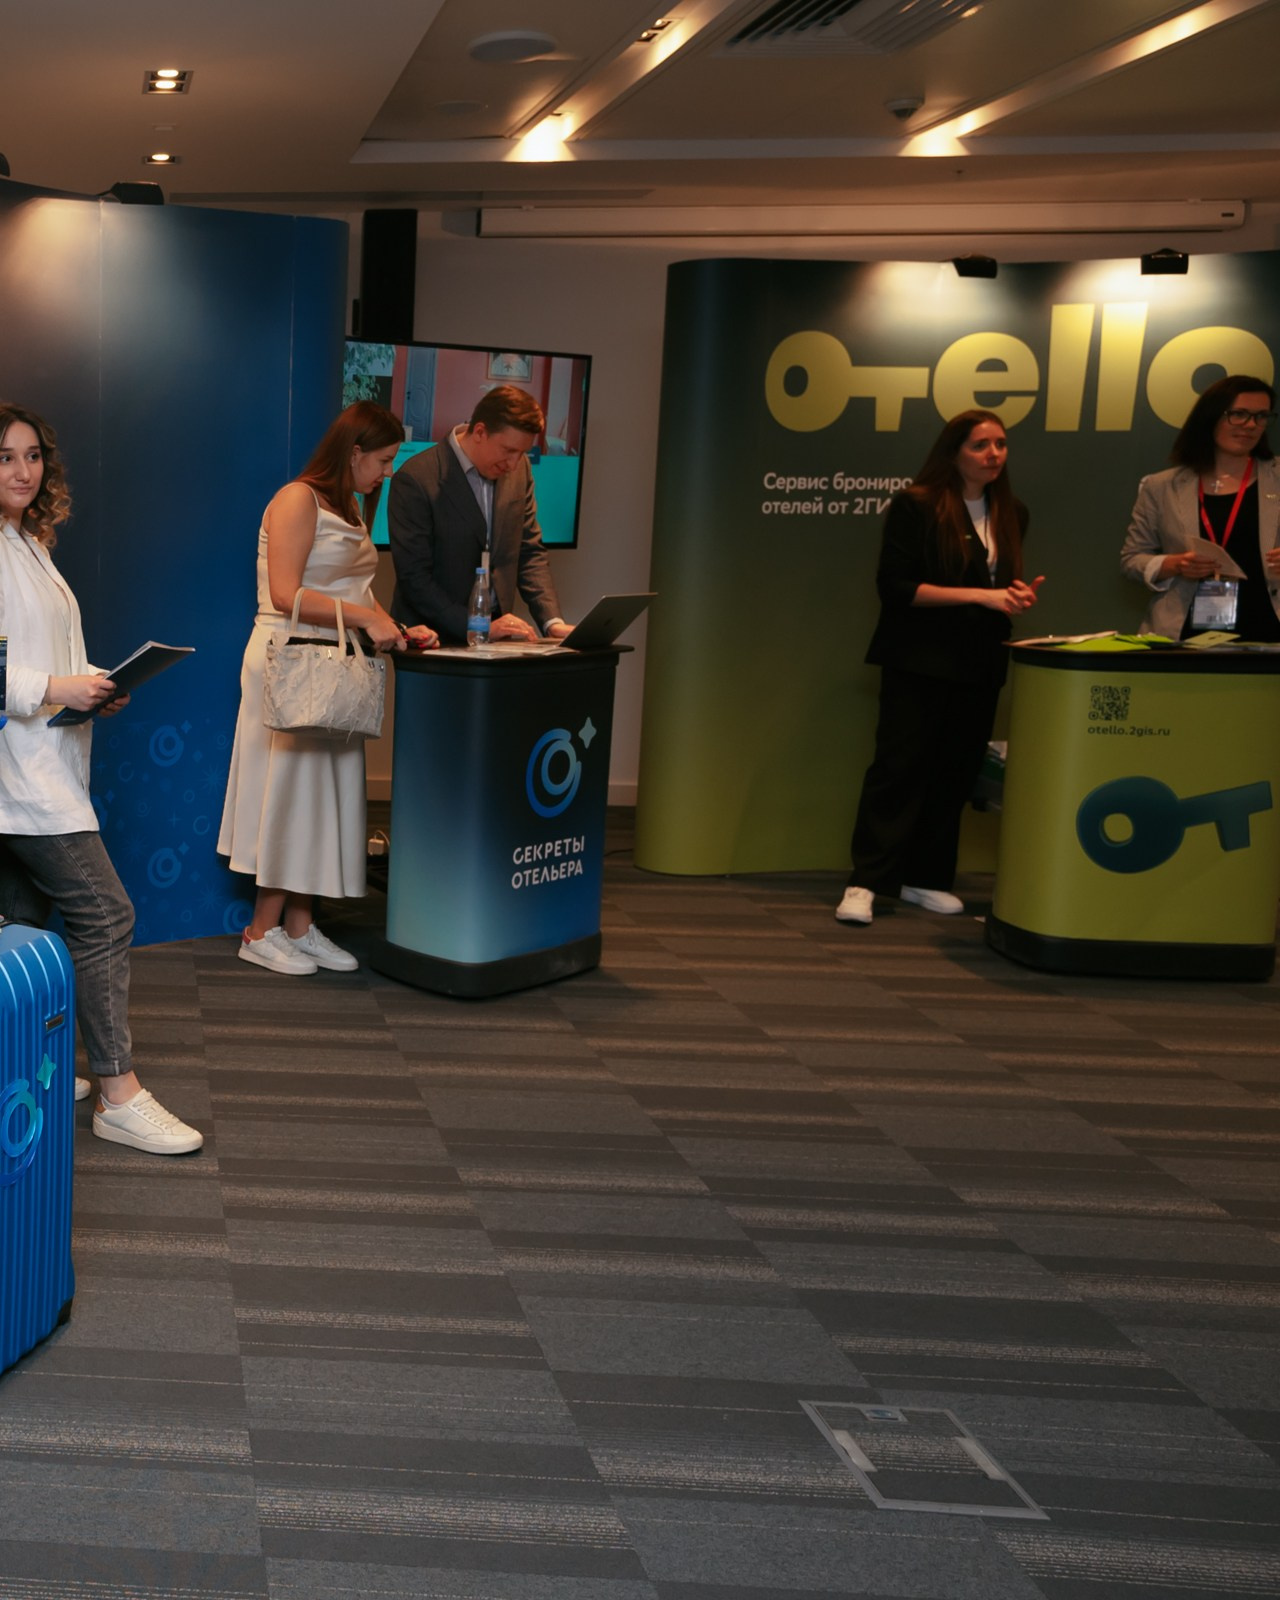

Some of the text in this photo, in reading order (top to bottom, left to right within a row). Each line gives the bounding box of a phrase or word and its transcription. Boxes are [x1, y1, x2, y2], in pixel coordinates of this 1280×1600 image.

[763, 471, 914, 494] Сервис брониро
[761, 497, 892, 515] отелей от 2ГИ
[1087, 725, 1171, 738] otello.2gis.ru
[512, 835, 585, 865] СЕКРЕТЫ
[511, 859, 584, 890] ОТЕЛЬЕРА
